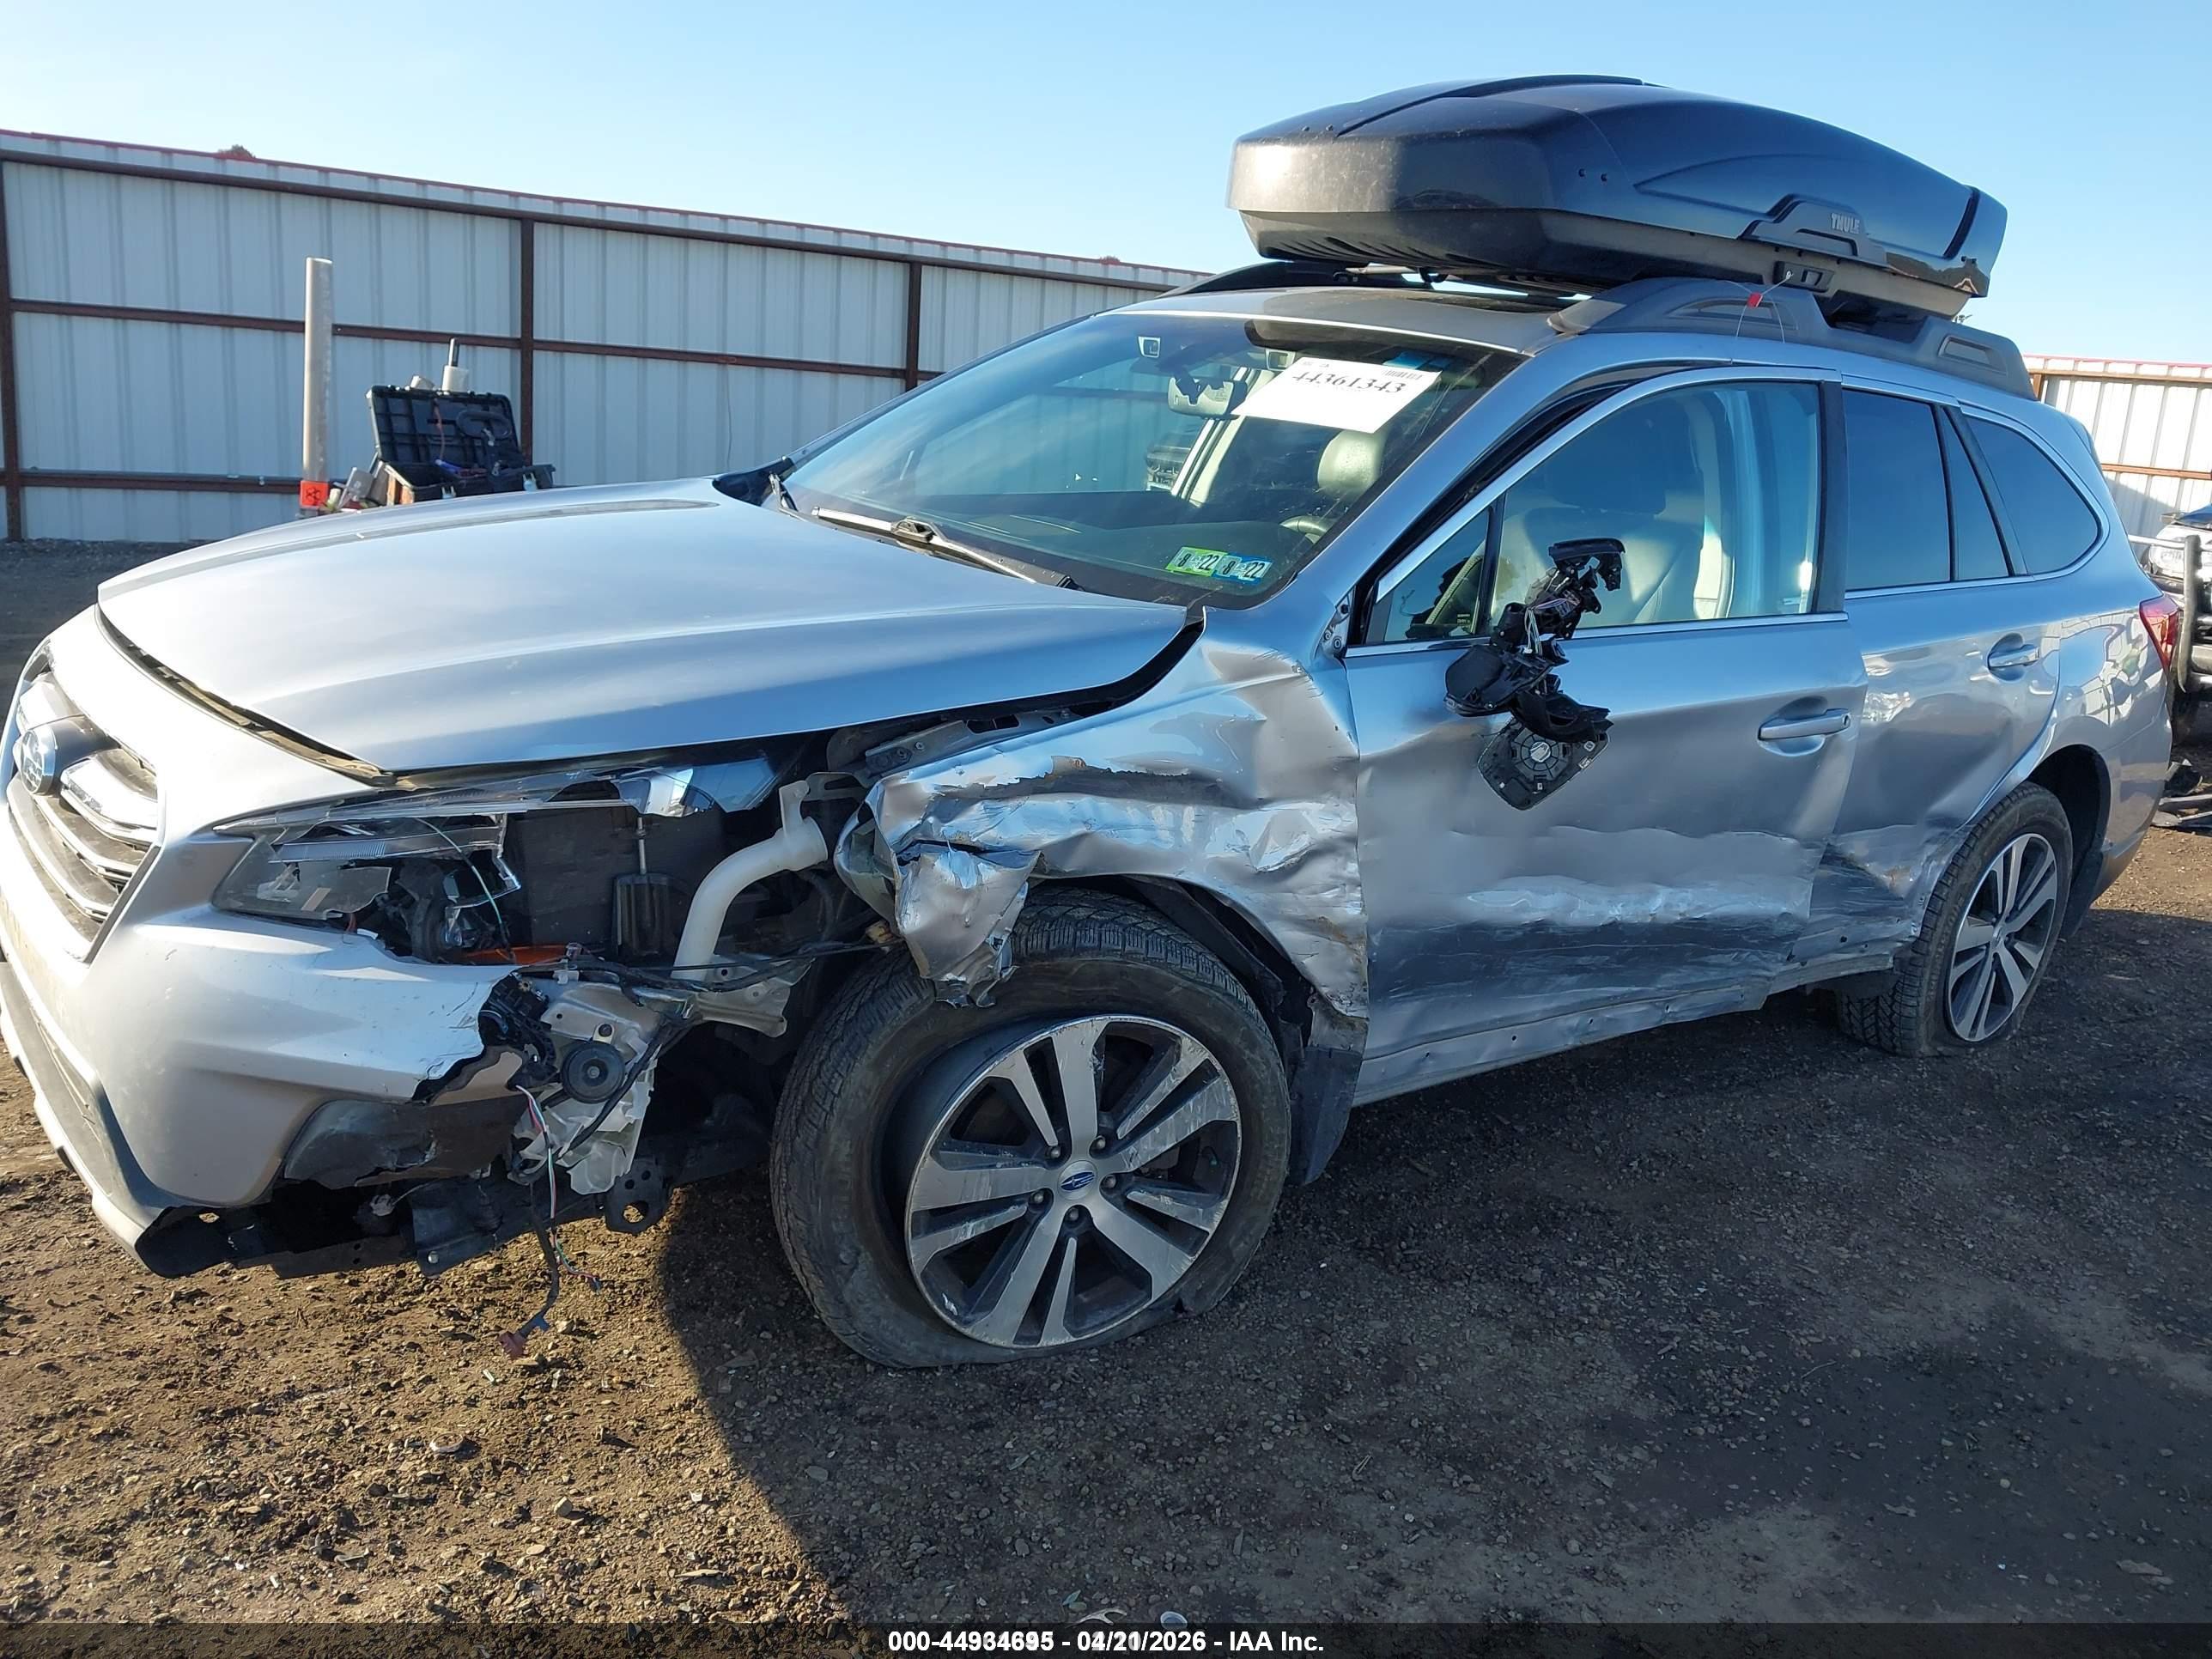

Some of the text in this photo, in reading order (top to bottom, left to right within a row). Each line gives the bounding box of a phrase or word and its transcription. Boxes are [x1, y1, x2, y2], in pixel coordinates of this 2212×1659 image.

[1830, 212, 1861, 234] THULE
[1198, 554, 1219, 571] 22
[1243, 562, 1266, 579] 22
